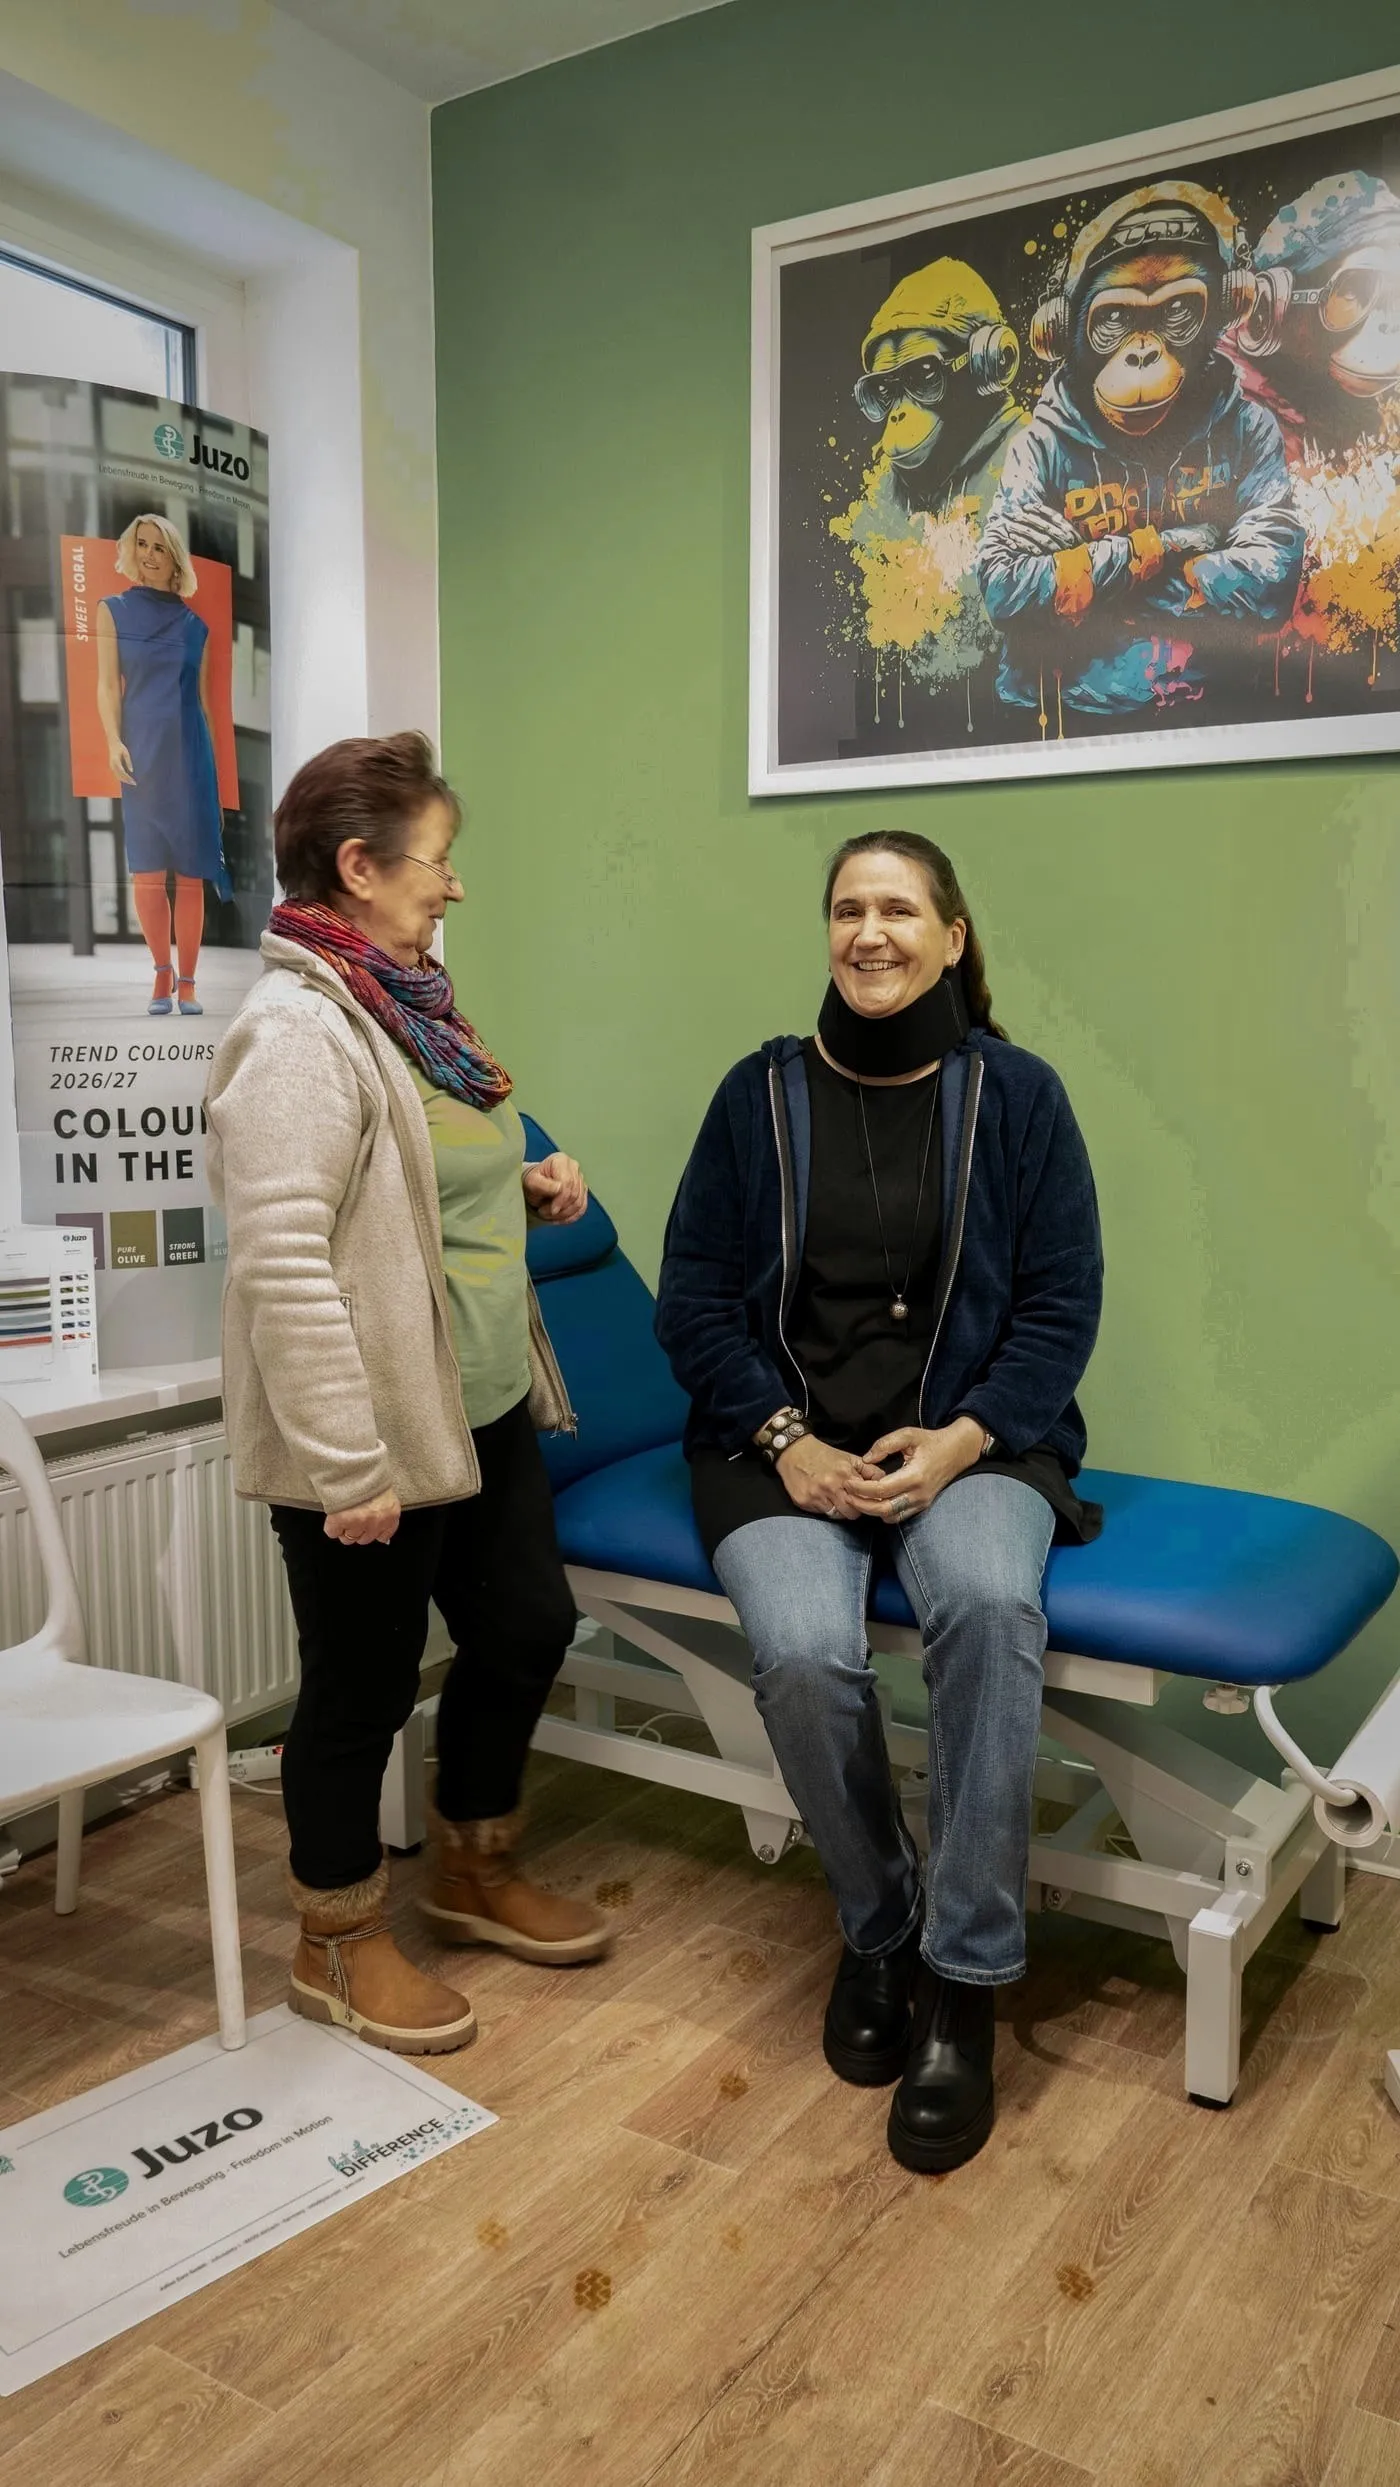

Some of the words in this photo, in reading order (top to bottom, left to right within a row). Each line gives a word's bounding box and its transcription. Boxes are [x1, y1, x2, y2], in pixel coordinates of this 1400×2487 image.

[99, 464, 149, 481] Lebensfreude
[189, 434, 250, 481] Juzo
[72, 545, 86, 593] CORAL
[74, 596, 89, 642] SWEET
[50, 1046, 118, 1062] TREND
[128, 1044, 215, 1062] COLOURS
[50, 1072, 138, 1089] 2026/27
[53, 1105, 207, 1140] COLOU
[56, 1152, 98, 1184] IN
[118, 1149, 193, 1182] THE
[117, 1246, 136, 1254] PURE
[117, 1254, 146, 1265] OLIVE
[169, 1241, 196, 1251] STRONG
[169, 1250, 198, 1262] GREEN
[131, 2107, 263, 2180] Juzo
[340, 2118, 444, 2178] DIFFERENCE
[58, 2211, 147, 2259] Lebensfreude
[146, 2203, 161, 2214] in
[160, 2170, 227, 2207] Bewegung
[230, 2141, 283, 2171] Freedom
[282, 2135, 295, 2145] in
[293, 2114, 334, 2138] Motion
